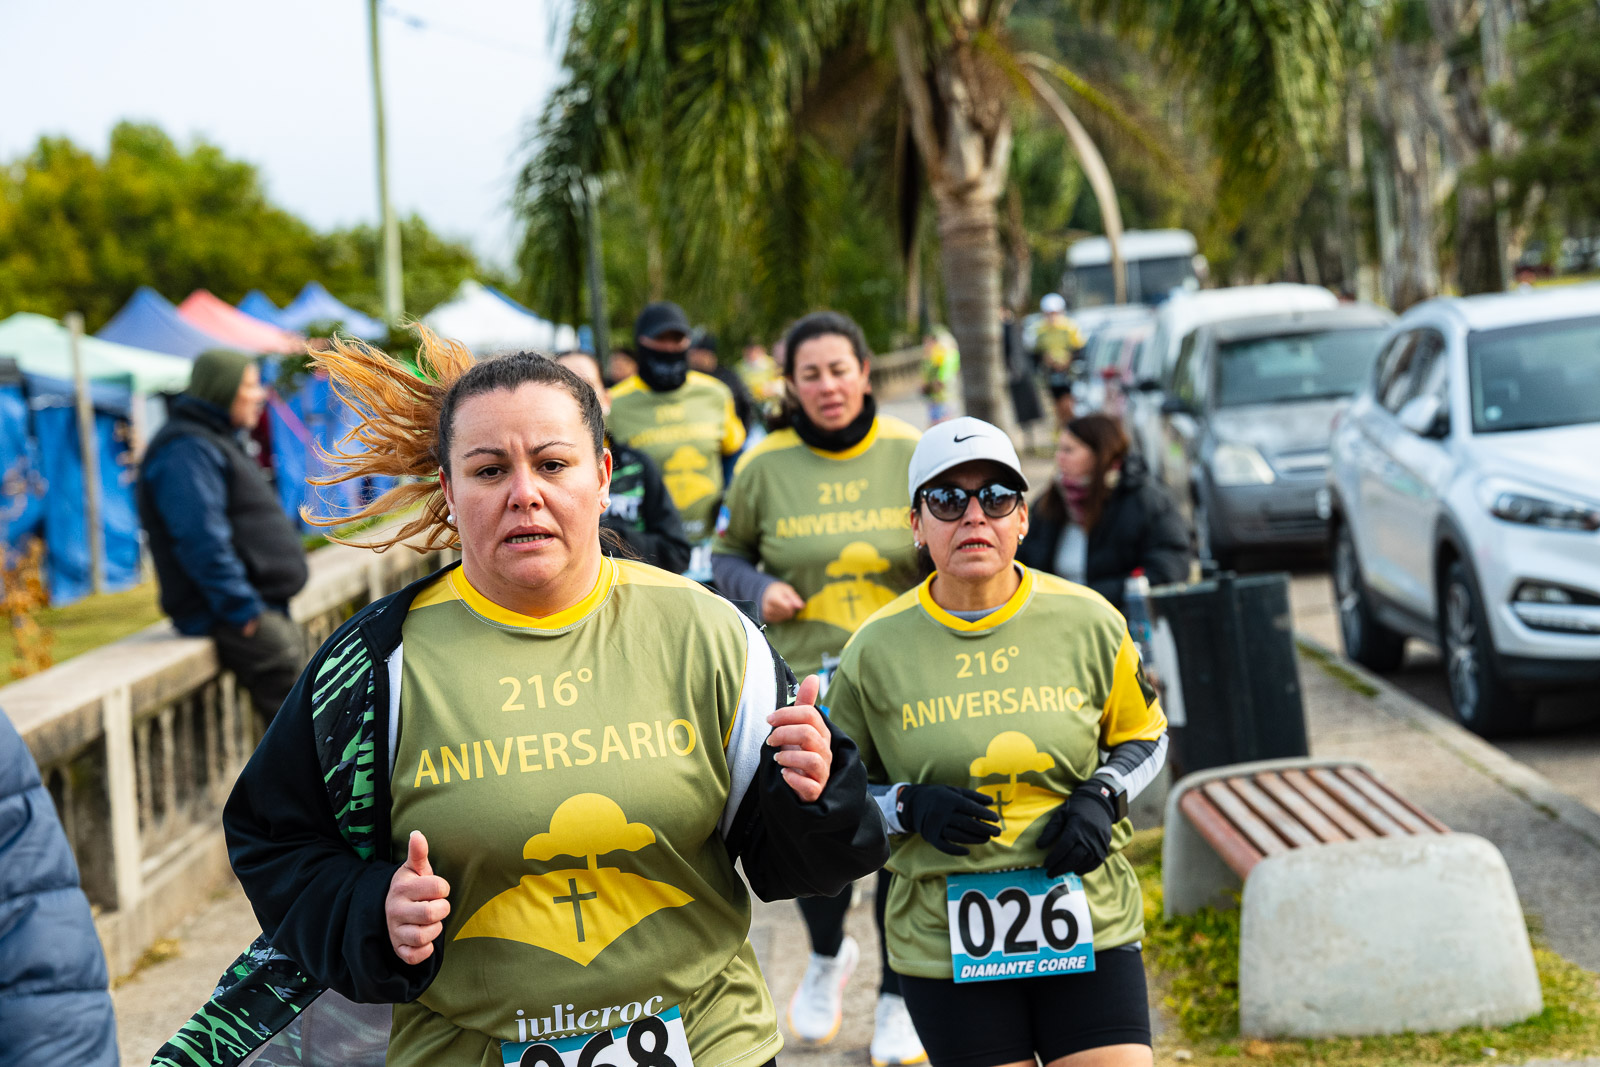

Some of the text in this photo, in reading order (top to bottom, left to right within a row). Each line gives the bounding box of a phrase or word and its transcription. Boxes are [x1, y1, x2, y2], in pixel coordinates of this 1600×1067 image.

[818, 478, 869, 504] 216°
[955, 645, 1020, 678] 216°
[499, 667, 593, 711] 216°
[902, 686, 1085, 730] ANIVERSARIO
[413, 718, 697, 788] ANIVERSARIO
[958, 883, 1079, 958] 026
[960, 955, 1087, 979] DIAMANTE CORRE
[515, 995, 663, 1042] julicroc
